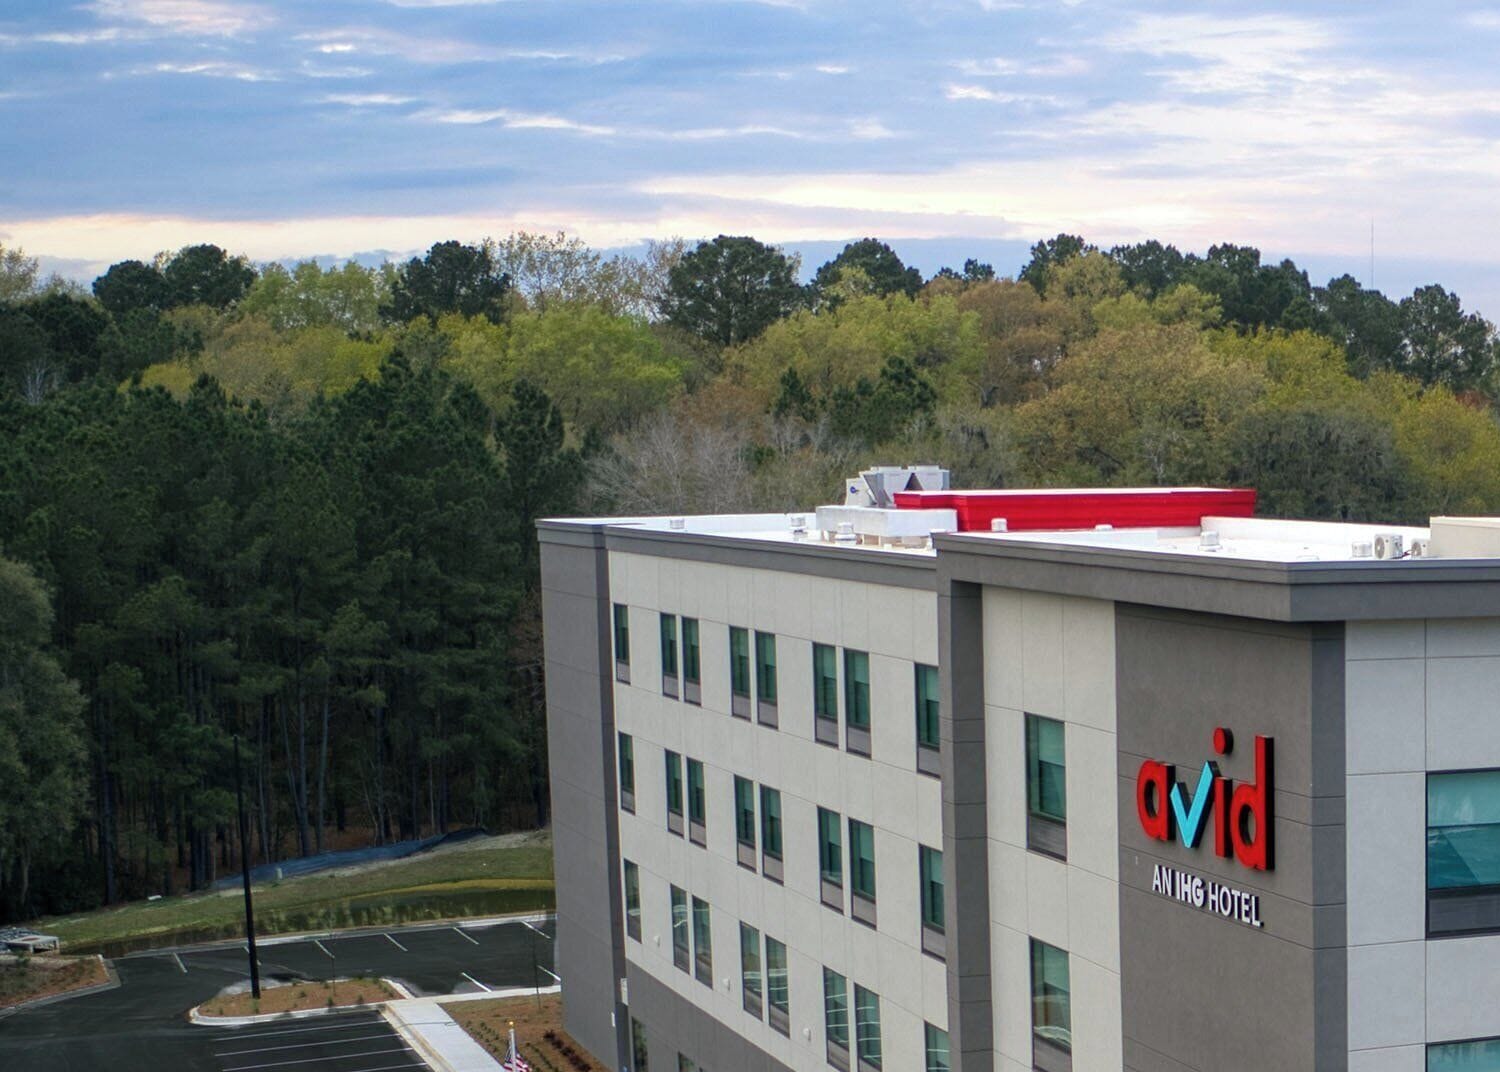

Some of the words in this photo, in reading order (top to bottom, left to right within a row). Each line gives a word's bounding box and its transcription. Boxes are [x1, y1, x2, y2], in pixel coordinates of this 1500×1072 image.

[1136, 727, 1274, 871] avid
[1152, 864, 1172, 897] AN
[1175, 871, 1204, 907] IHG
[1208, 881, 1261, 927] HOTEL
